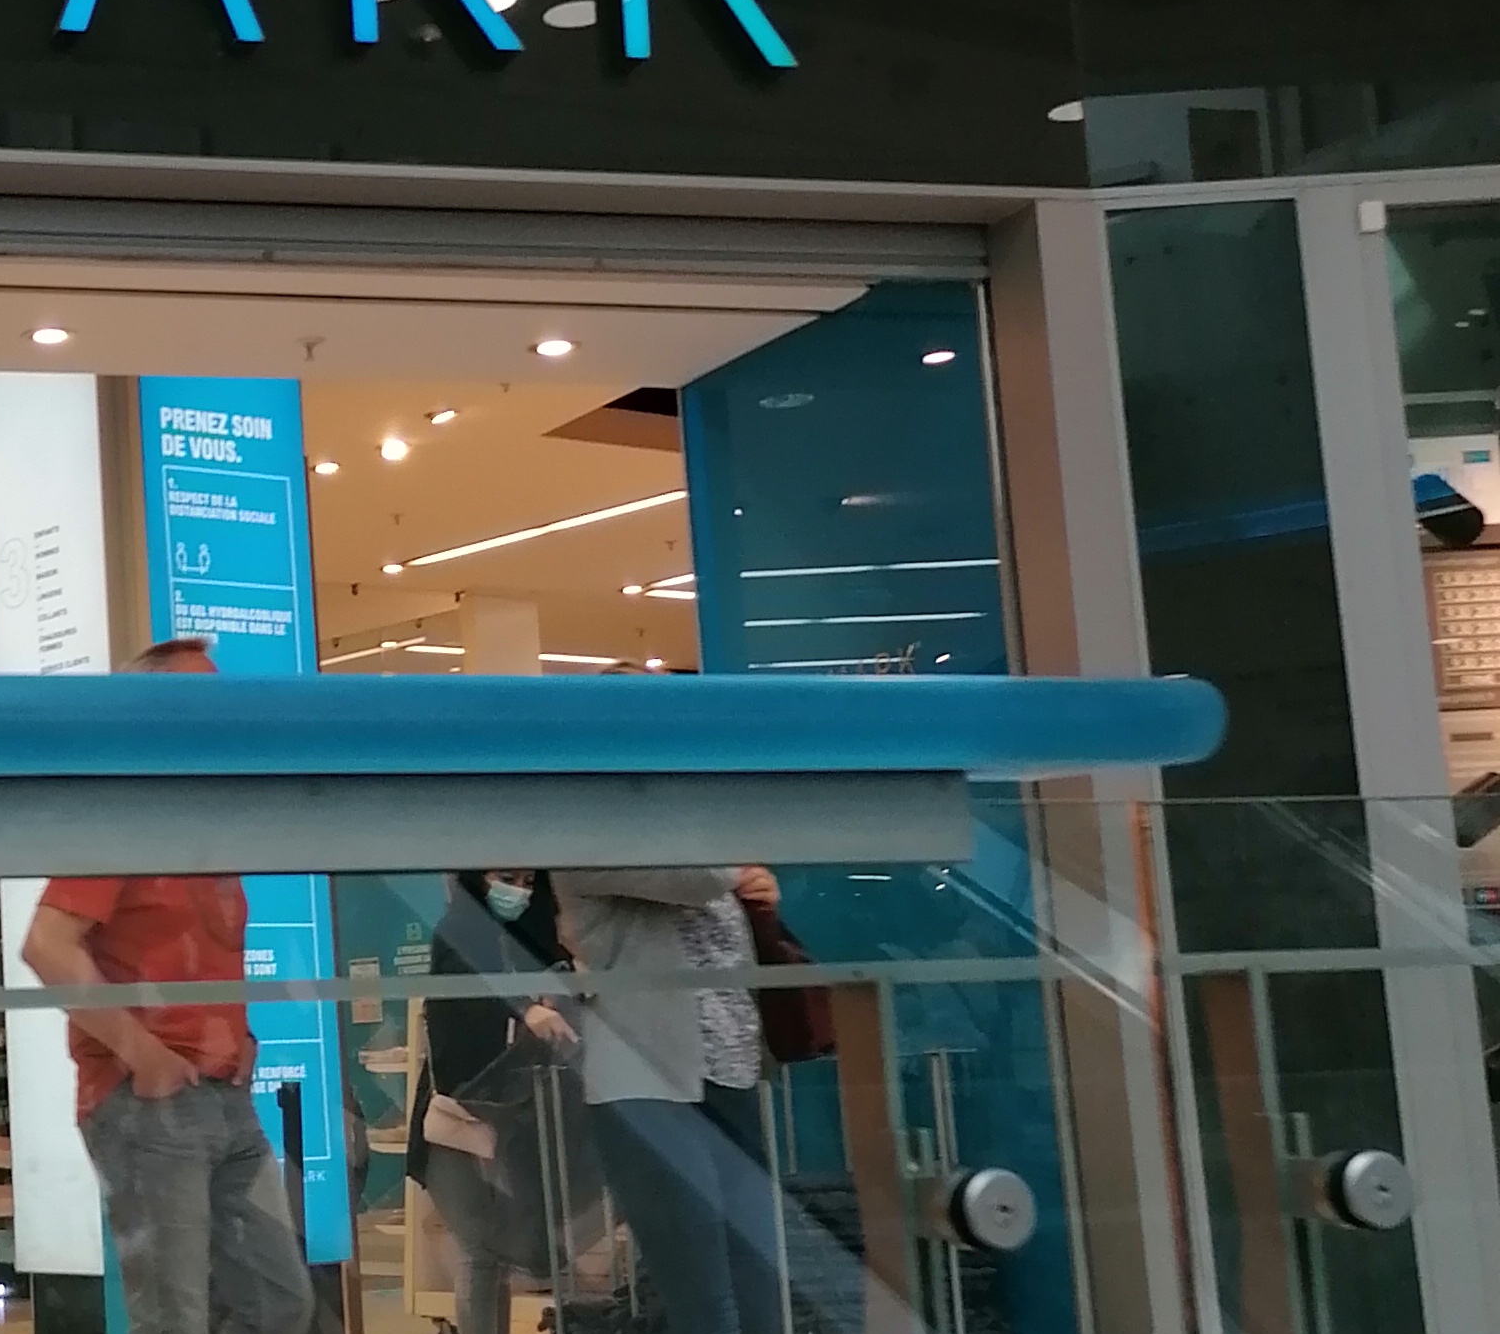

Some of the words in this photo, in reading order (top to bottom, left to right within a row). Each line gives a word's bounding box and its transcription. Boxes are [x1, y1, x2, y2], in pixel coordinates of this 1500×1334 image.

[160, 406, 229, 435] PRENEZ
[231, 414, 273, 440] SOIN
[161, 433, 186, 457] DE
[188, 436, 243, 464] VOUS.
[0, 537, 30, 610] 3
